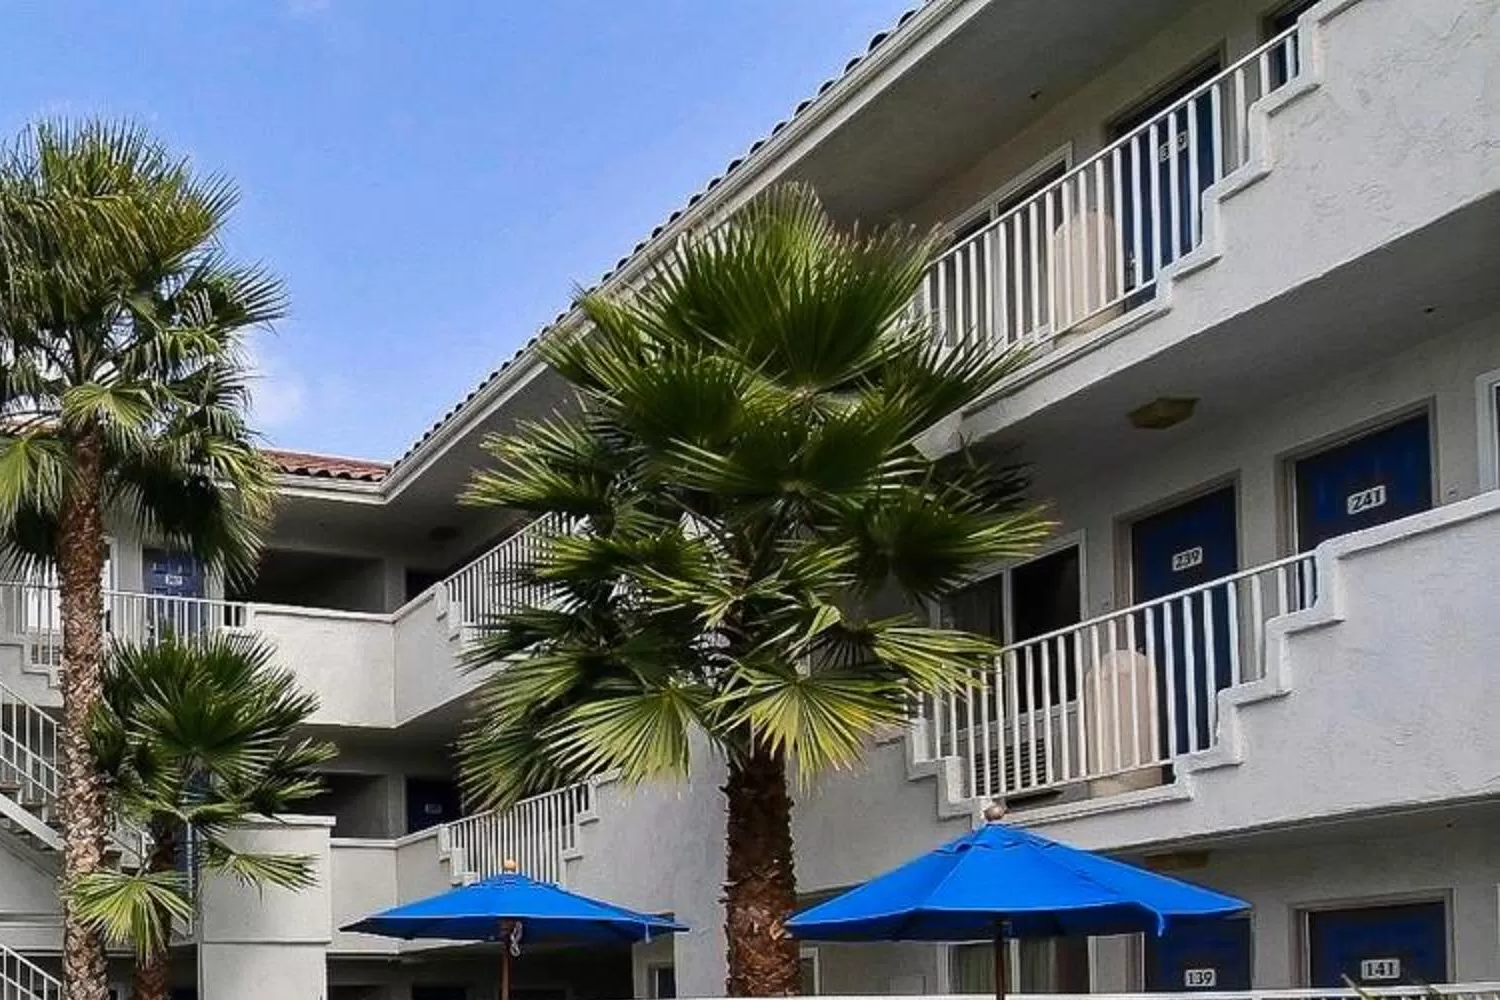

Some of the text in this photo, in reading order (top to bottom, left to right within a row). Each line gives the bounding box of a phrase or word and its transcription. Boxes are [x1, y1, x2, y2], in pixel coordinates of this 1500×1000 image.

[1352, 490, 1380, 510] 241
[1366, 960, 1394, 976] 141
[1187, 971, 1214, 985] 139
